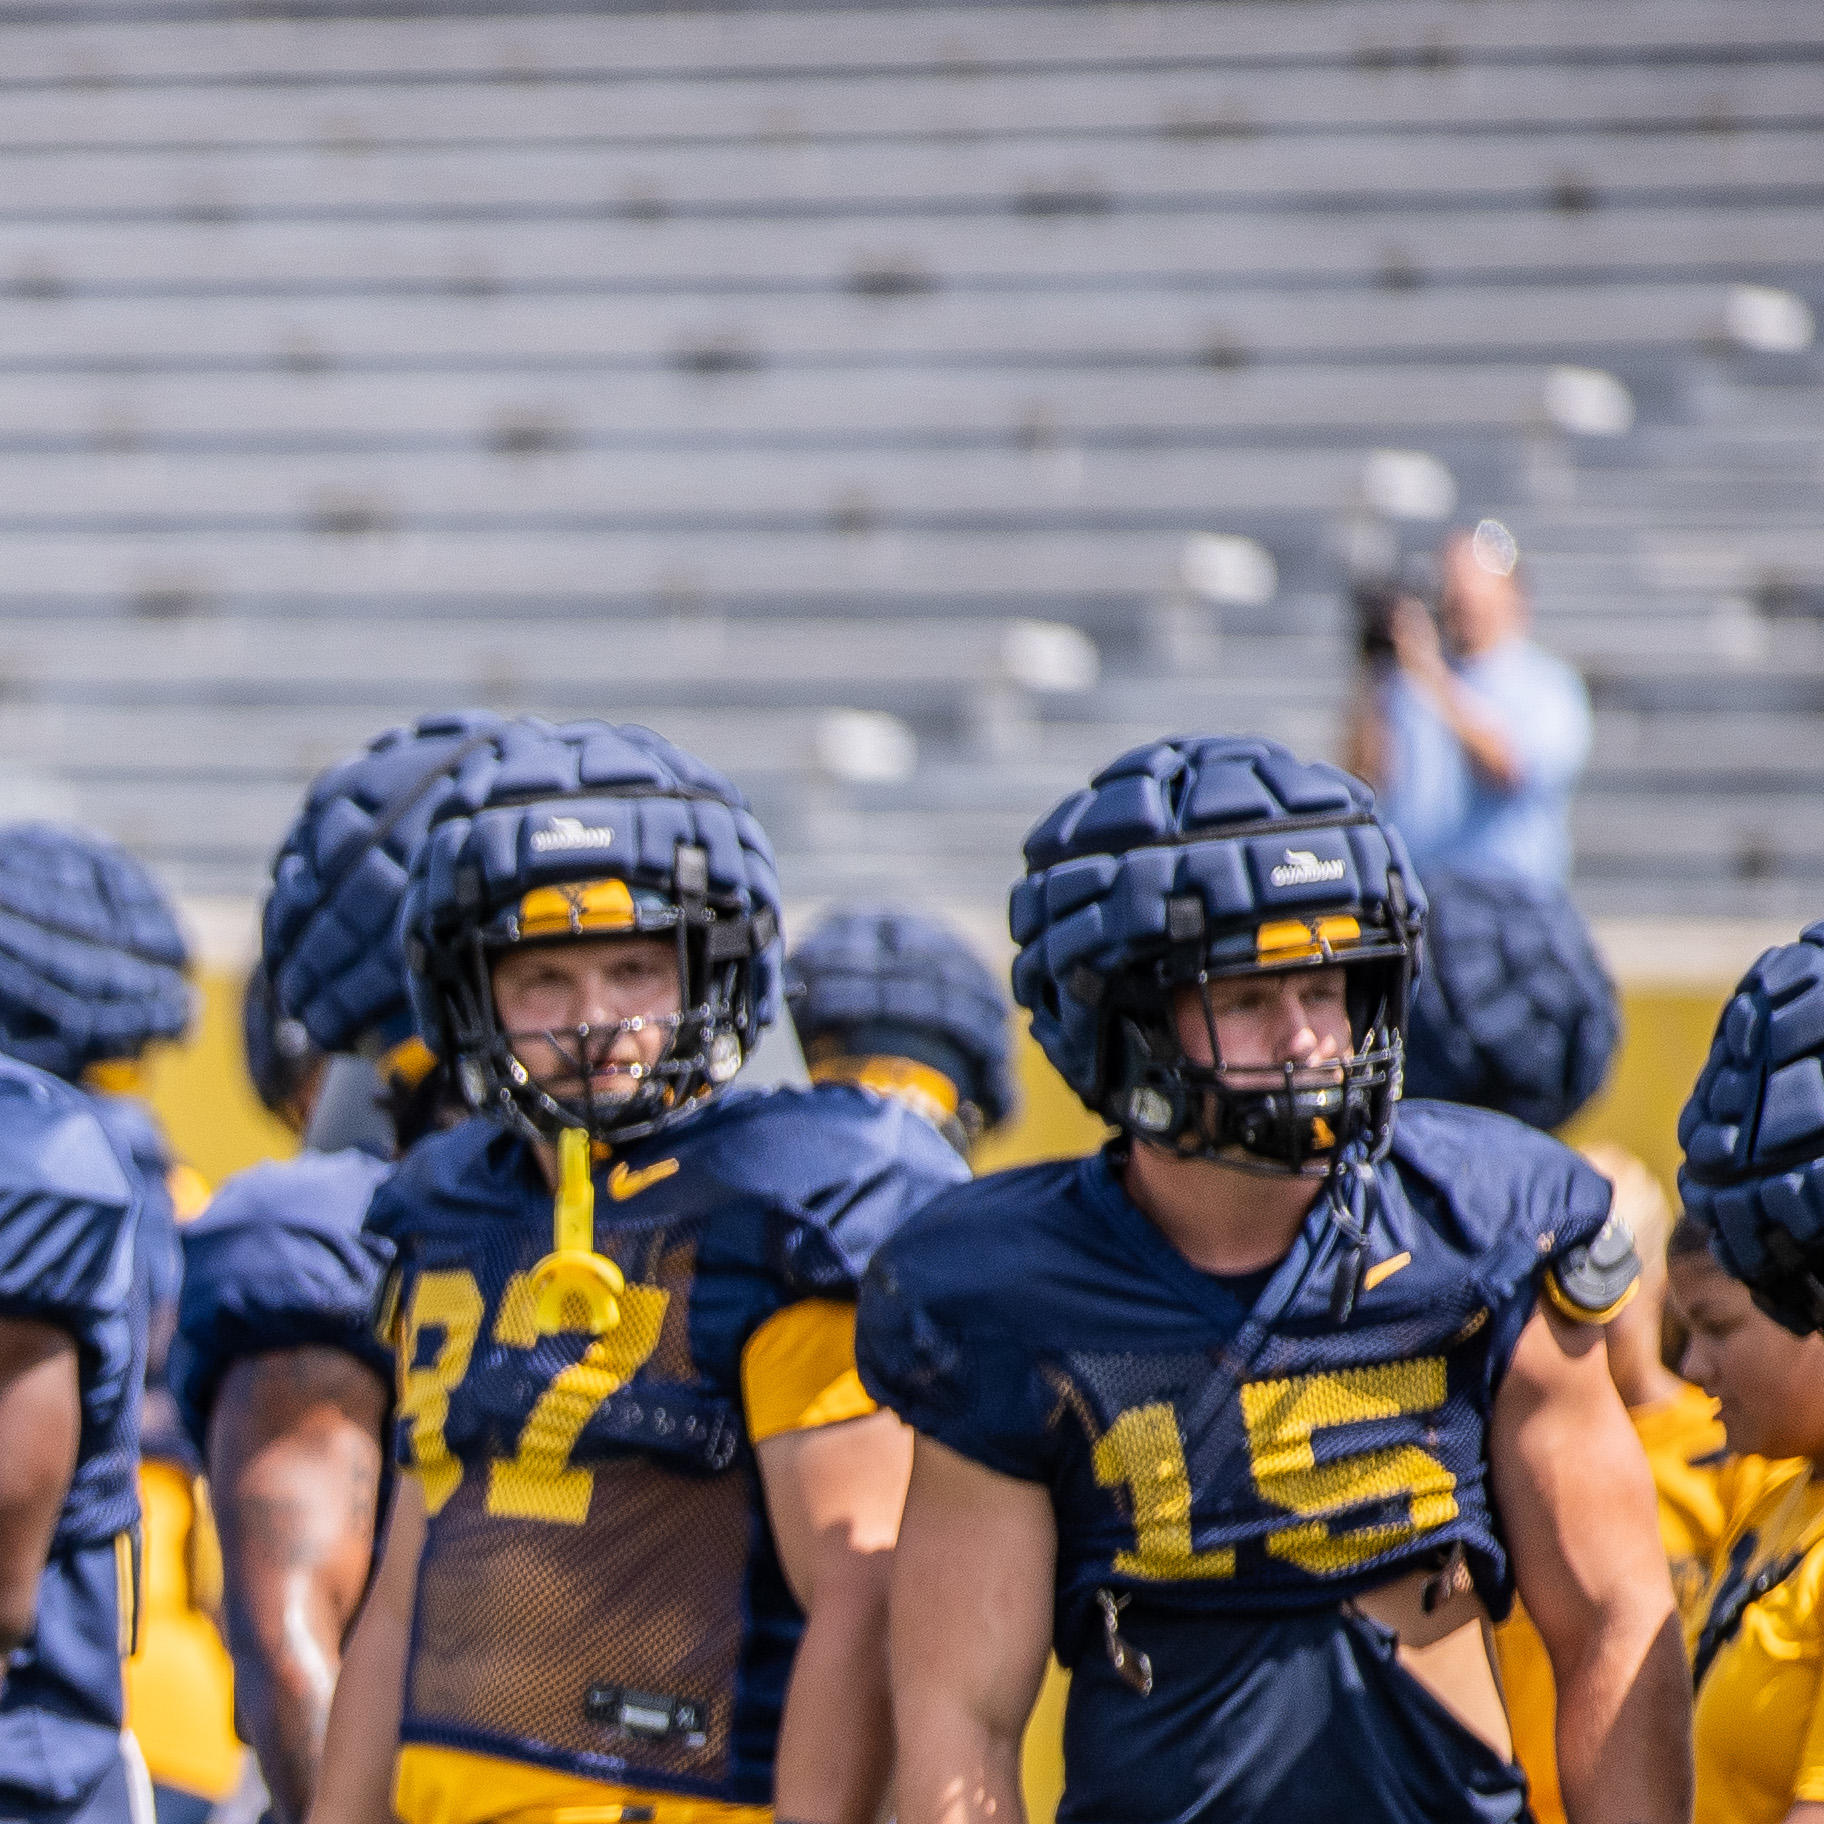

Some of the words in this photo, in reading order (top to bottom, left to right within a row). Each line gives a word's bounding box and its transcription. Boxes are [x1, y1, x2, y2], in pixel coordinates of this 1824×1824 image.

[1271, 859, 1346, 887] GUARDIAN
[394, 1266, 669, 1525] 87
[1092, 1360, 1459, 1579] 15
